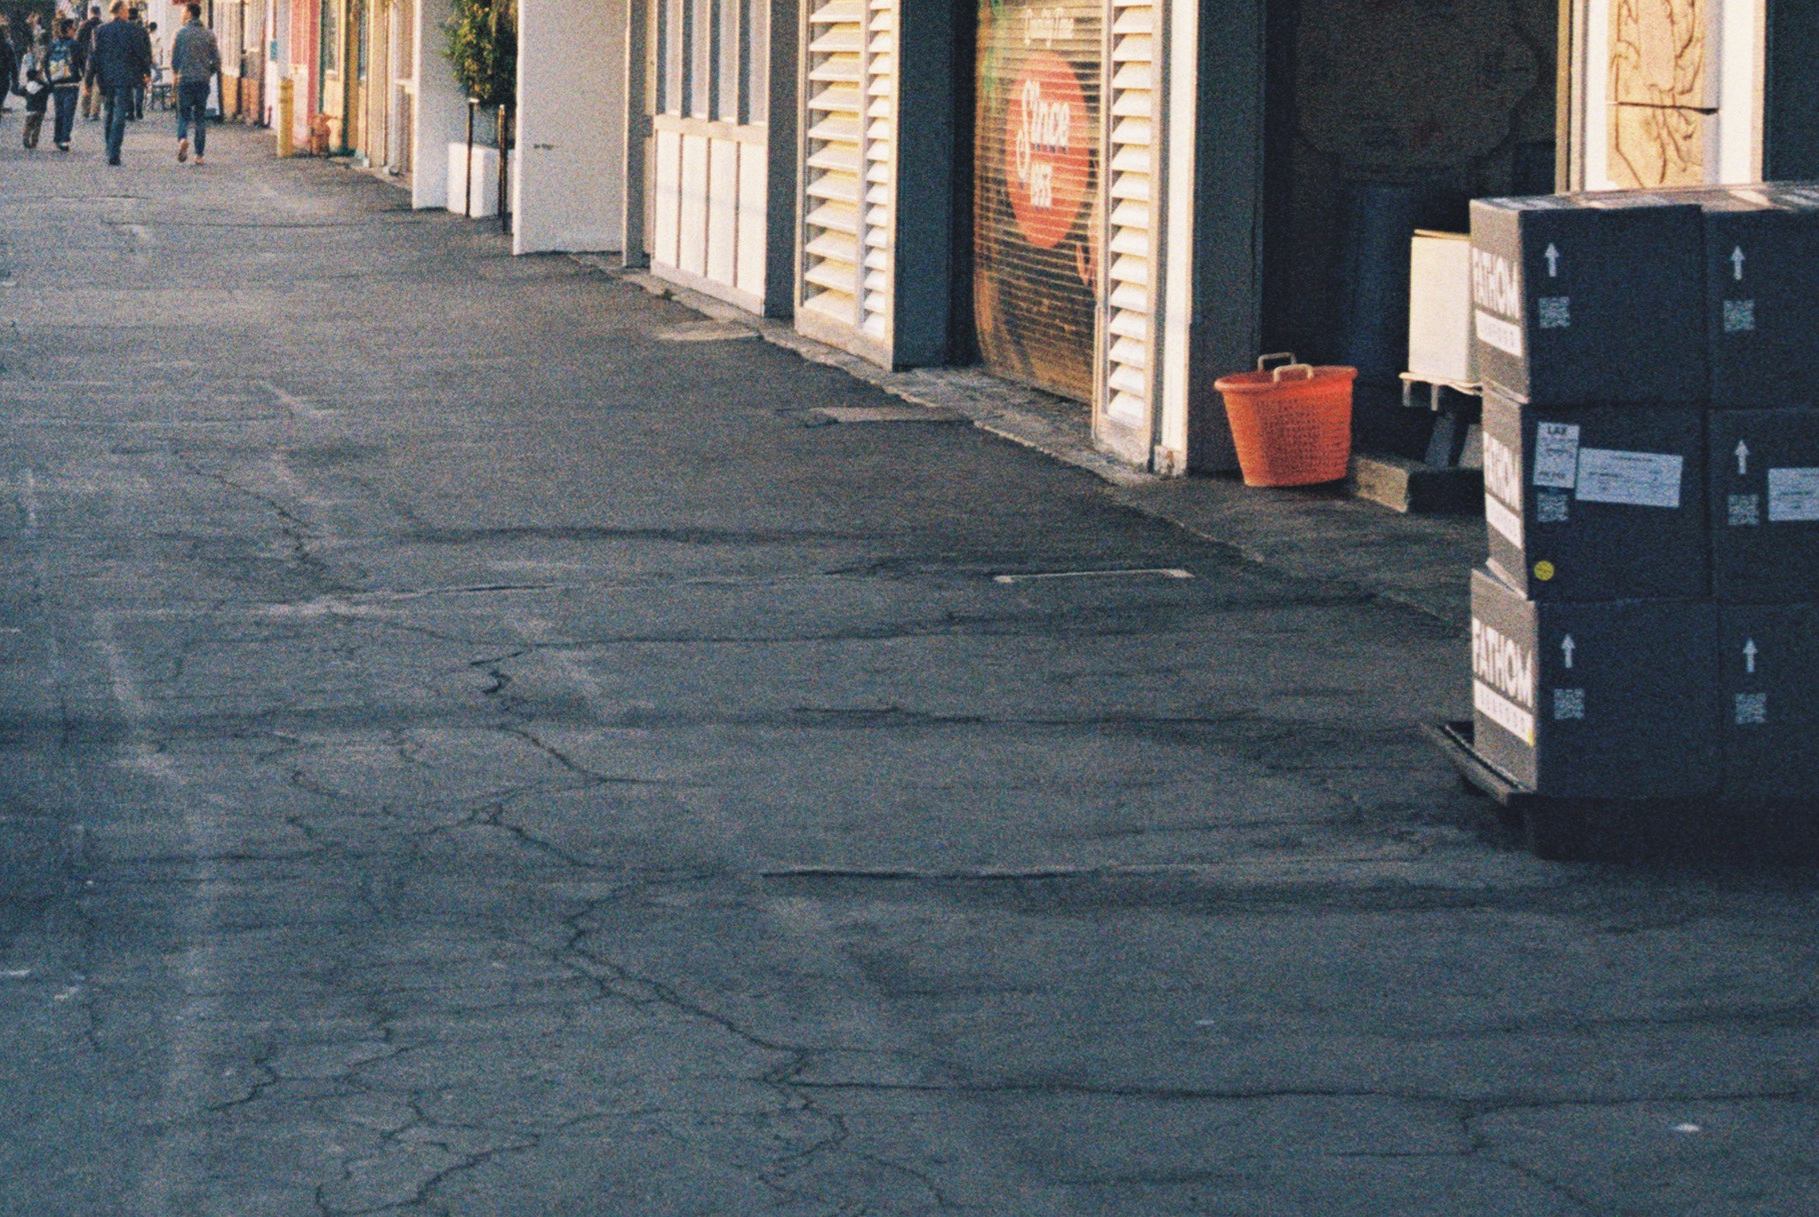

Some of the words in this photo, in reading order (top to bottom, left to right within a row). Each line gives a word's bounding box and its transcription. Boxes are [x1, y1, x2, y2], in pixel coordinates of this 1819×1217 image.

[1016, 78, 1070, 186] Since
[1472, 245, 1520, 320] FATHOM
[1471, 616, 1532, 710] FATHOM
